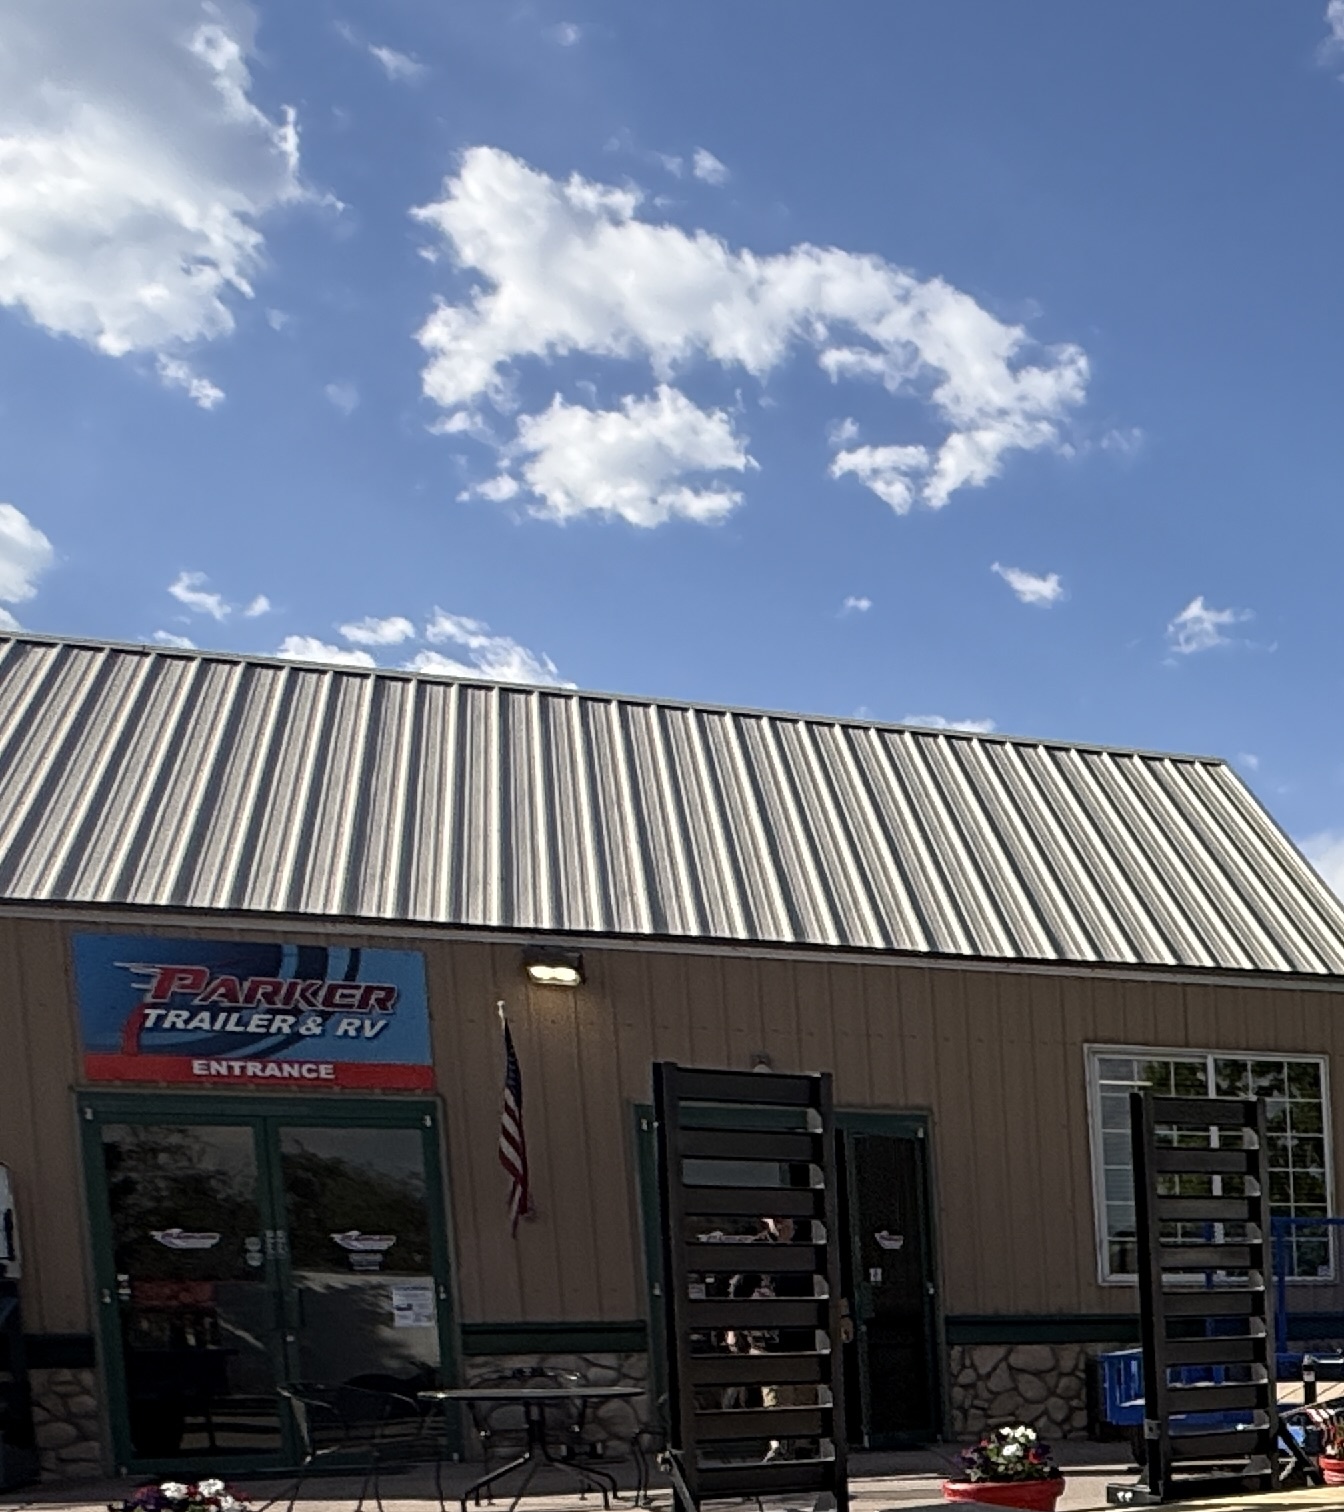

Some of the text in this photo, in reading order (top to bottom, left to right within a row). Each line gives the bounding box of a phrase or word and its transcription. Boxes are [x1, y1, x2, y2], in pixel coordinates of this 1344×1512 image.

[145, 964, 398, 1014] PARKER
[143, 1008, 389, 1039] TRAILER & RV
[191, 1060, 336, 1080] ENTRANCE
